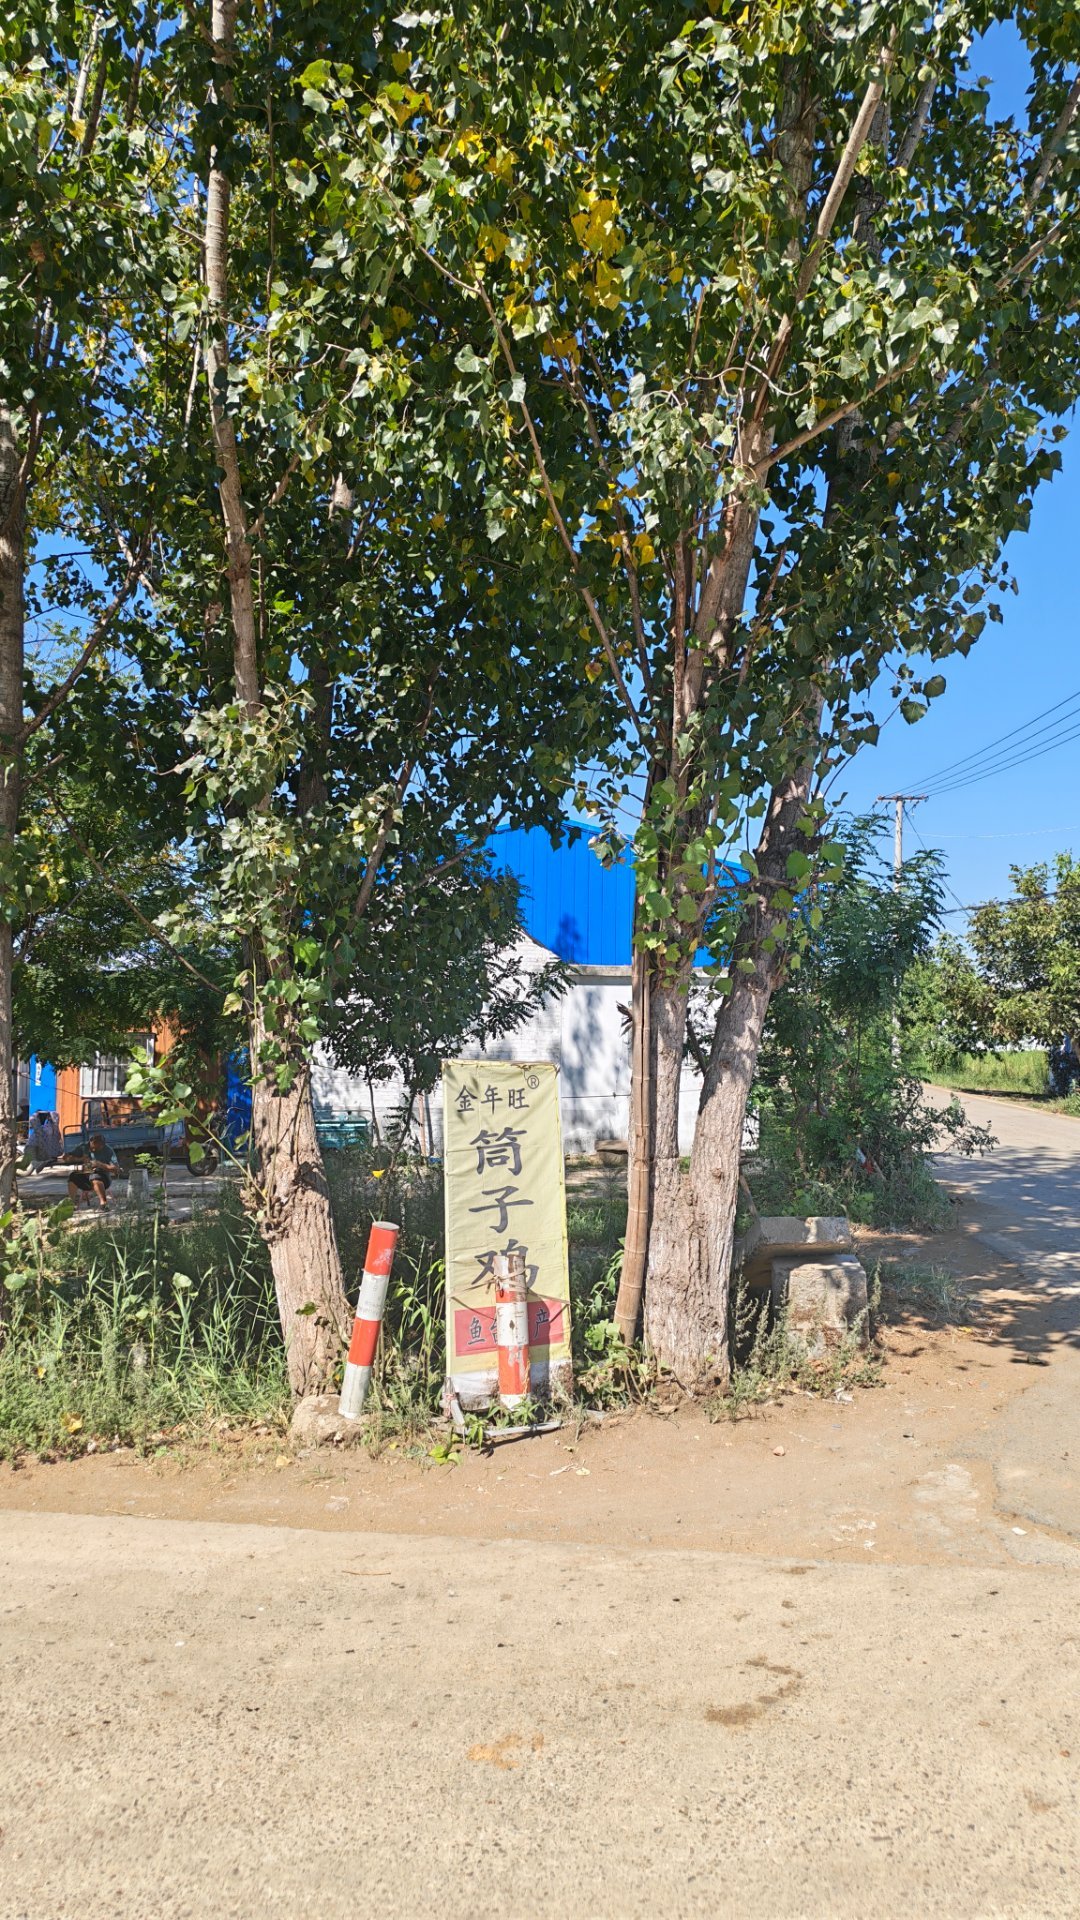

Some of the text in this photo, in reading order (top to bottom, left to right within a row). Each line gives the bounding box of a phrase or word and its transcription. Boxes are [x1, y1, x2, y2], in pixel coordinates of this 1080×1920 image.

[455, 1084, 530, 1115] 金年旺
[468, 1127, 540, 1292] 筒子鸡
